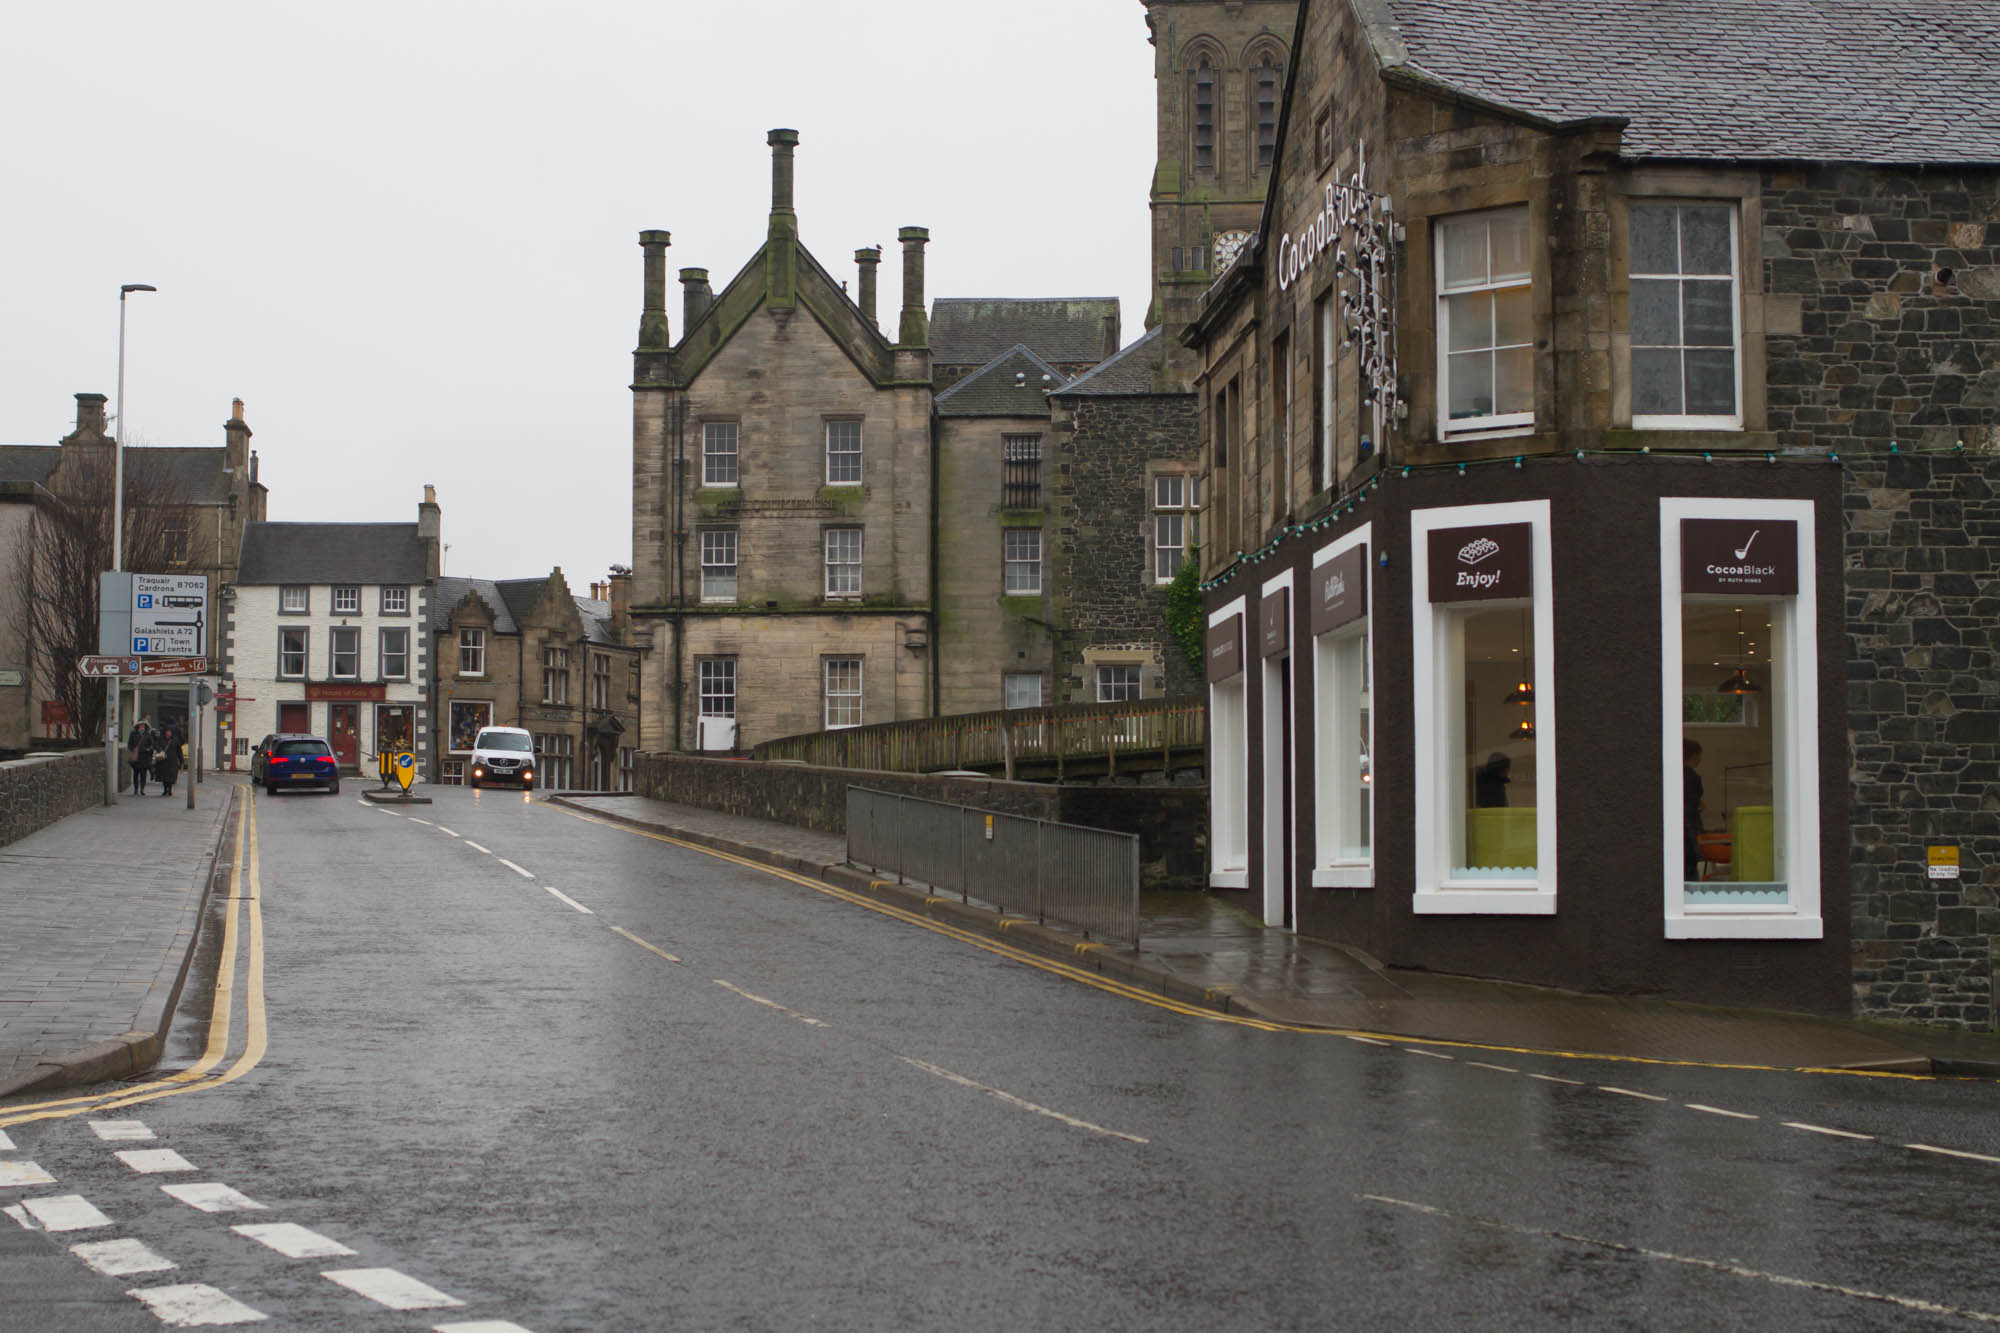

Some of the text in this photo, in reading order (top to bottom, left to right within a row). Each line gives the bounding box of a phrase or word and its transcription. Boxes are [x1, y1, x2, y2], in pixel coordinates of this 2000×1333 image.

[1706, 564, 1775, 575] CocoaBlack
[138, 577, 171, 585] Traquair
[1456, 570, 1501, 589] Enjoy!
[134, 627, 175, 635] Galashiels
